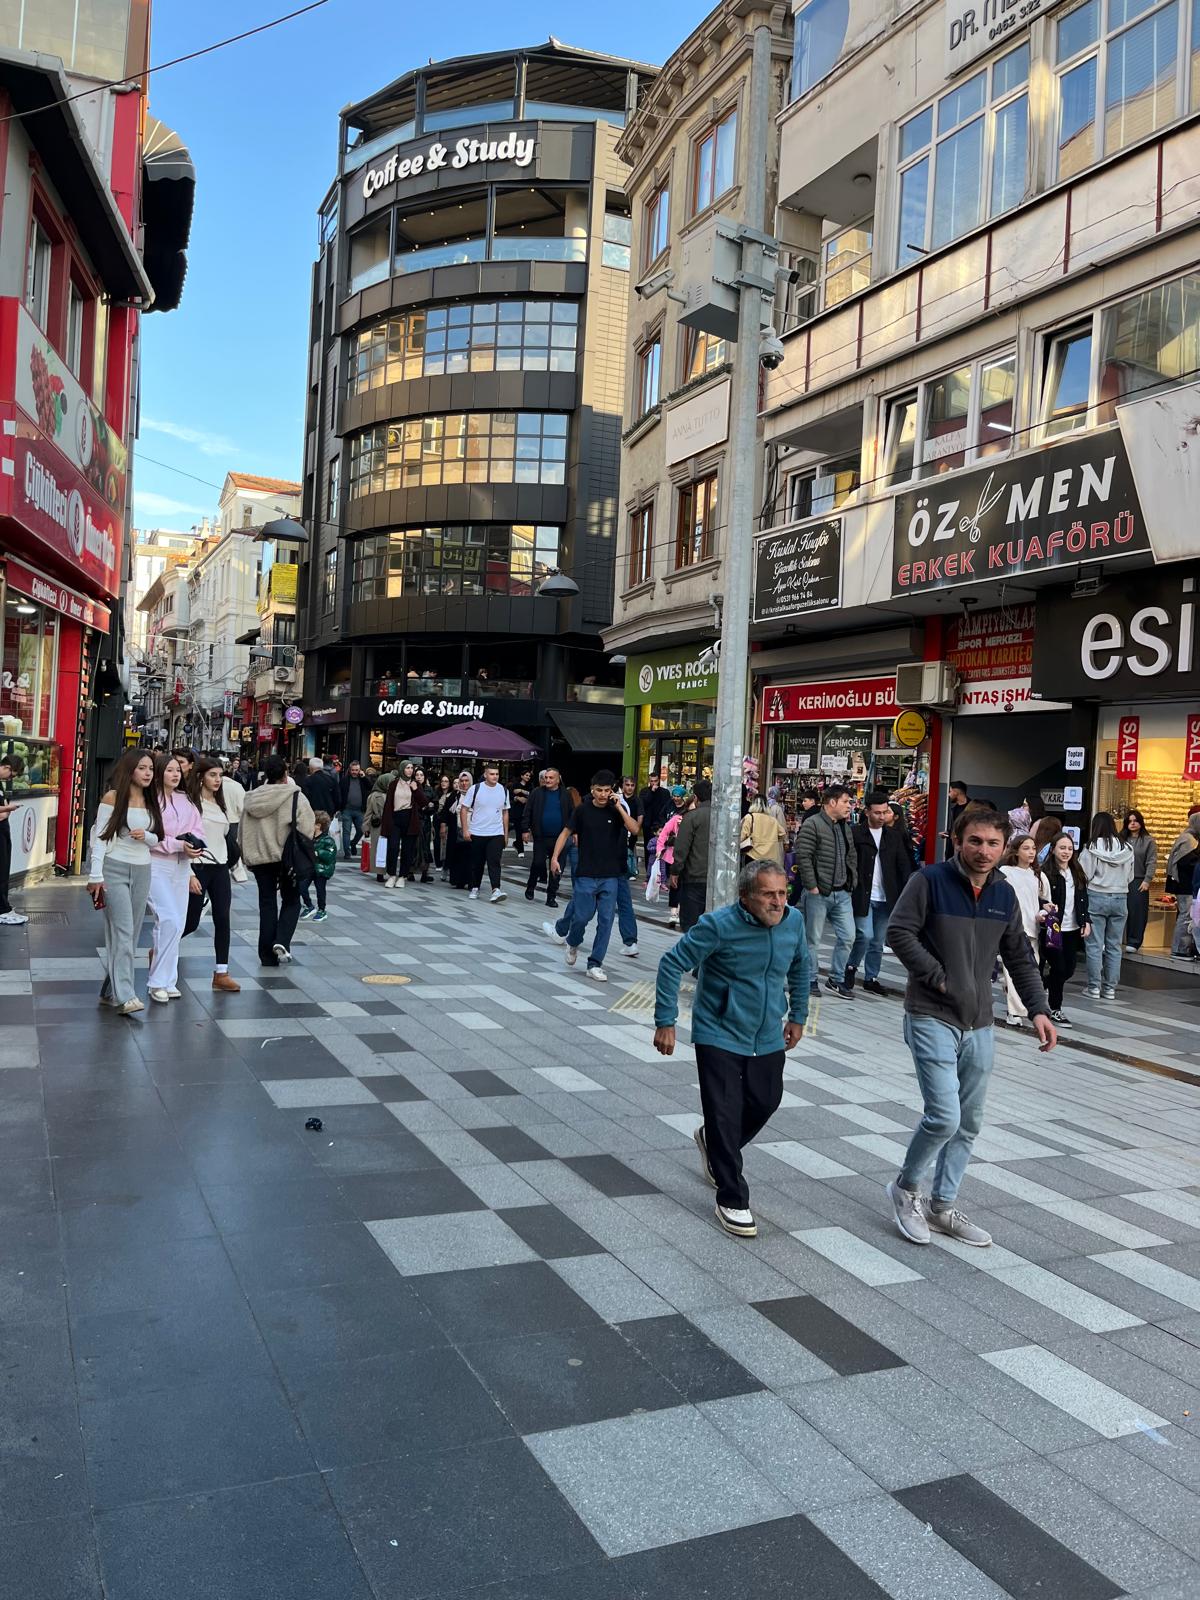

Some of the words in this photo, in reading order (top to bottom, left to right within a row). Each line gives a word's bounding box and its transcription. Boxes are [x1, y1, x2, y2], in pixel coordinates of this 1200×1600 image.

[949, 9, 979, 51] DR.
[988, 14, 1016, 40] 0462
[362, 154, 424, 199] Coffee
[426, 142, 447, 171] &
[451, 132, 536, 169] Study
[907, 498, 960, 547] ÖZ
[1005, 456, 1116, 525] MEN
[897, 549, 976, 586] ERKEK
[988, 510, 1135, 569] KUAFÖRÜ
[1081, 578, 1195, 680] esi
[957, 638, 982, 650] SPOR
[656, 663, 682, 681] YVES
[676, 679, 708, 690] FRANCE
[378, 699, 419, 716] Coffee
[421, 700, 434, 715] &
[436, 700, 485, 719] Study
[798, 689, 872, 710] KERİMOĞLU
[825, 736, 868, 747] KERİMOĞLU
[1121, 722, 1137, 773] SALE
